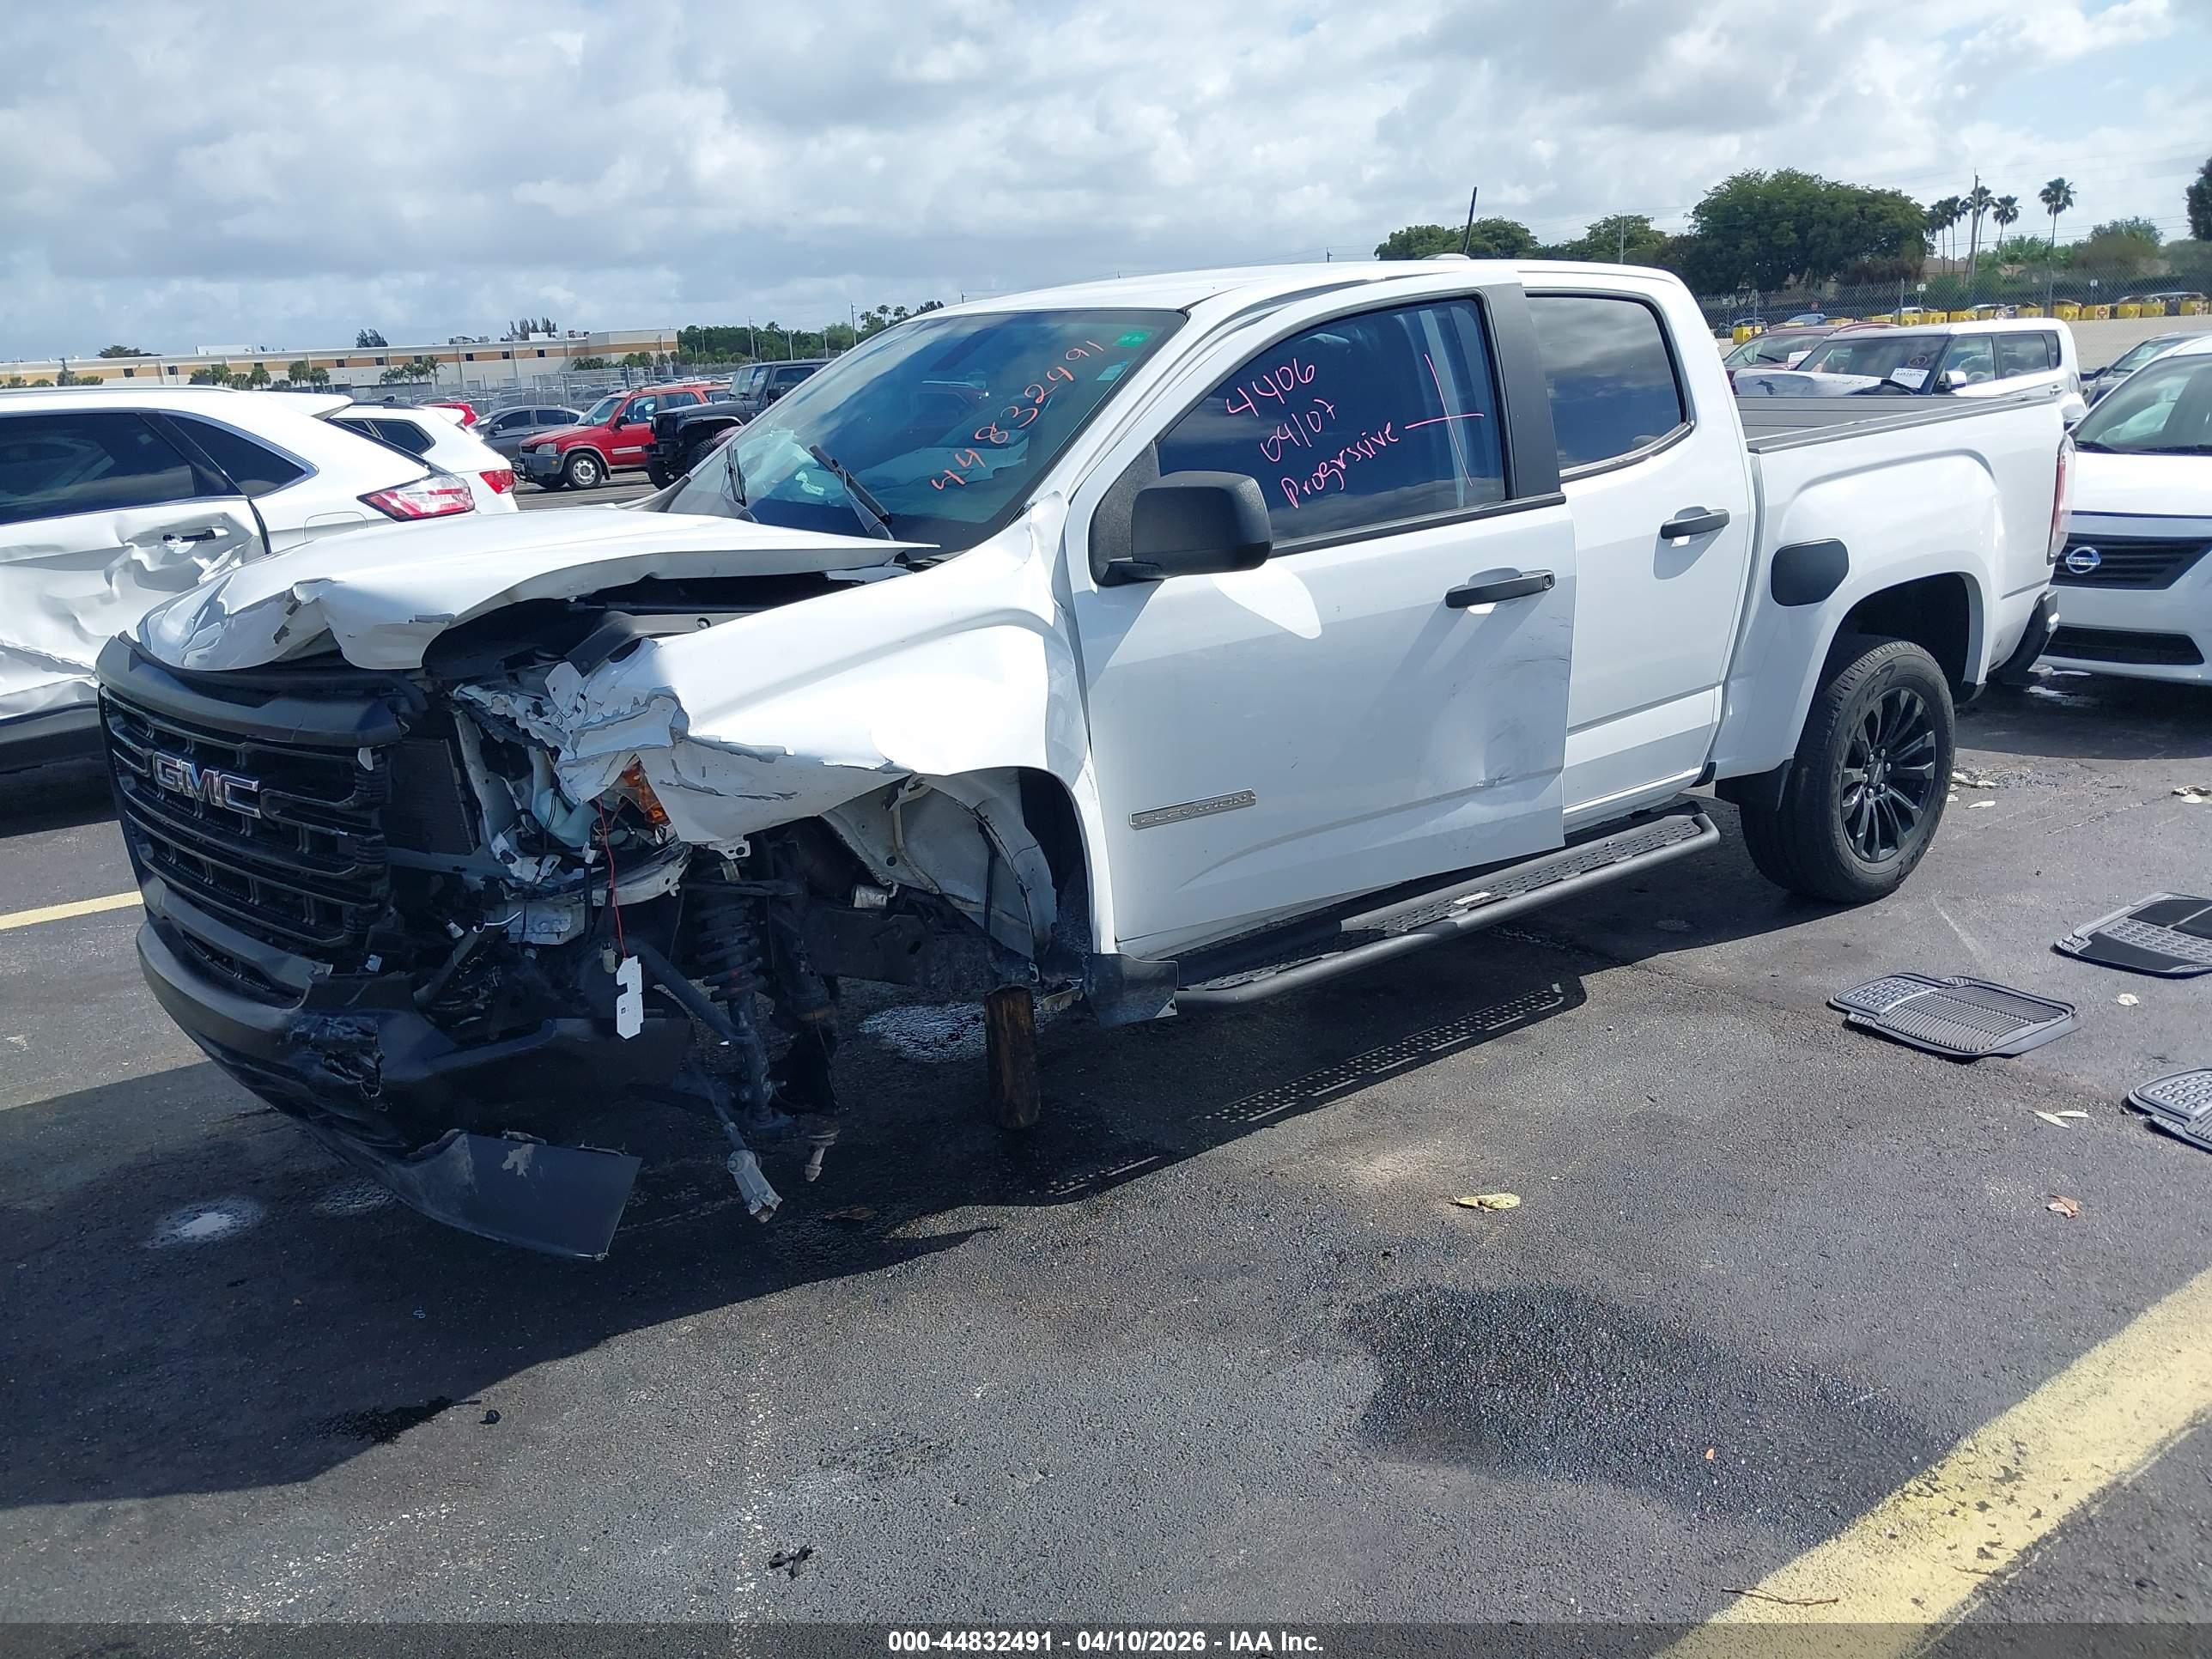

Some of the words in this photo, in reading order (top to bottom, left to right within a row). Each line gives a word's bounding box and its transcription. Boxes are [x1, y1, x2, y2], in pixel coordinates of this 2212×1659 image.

[931, 340, 1104, 490] 44832491
[1225, 357, 1316, 417] 4406
[1260, 398, 1336, 462] 04/07
[153, 750, 261, 819] GMC
[1140, 793, 1249, 824] ELEVATION
